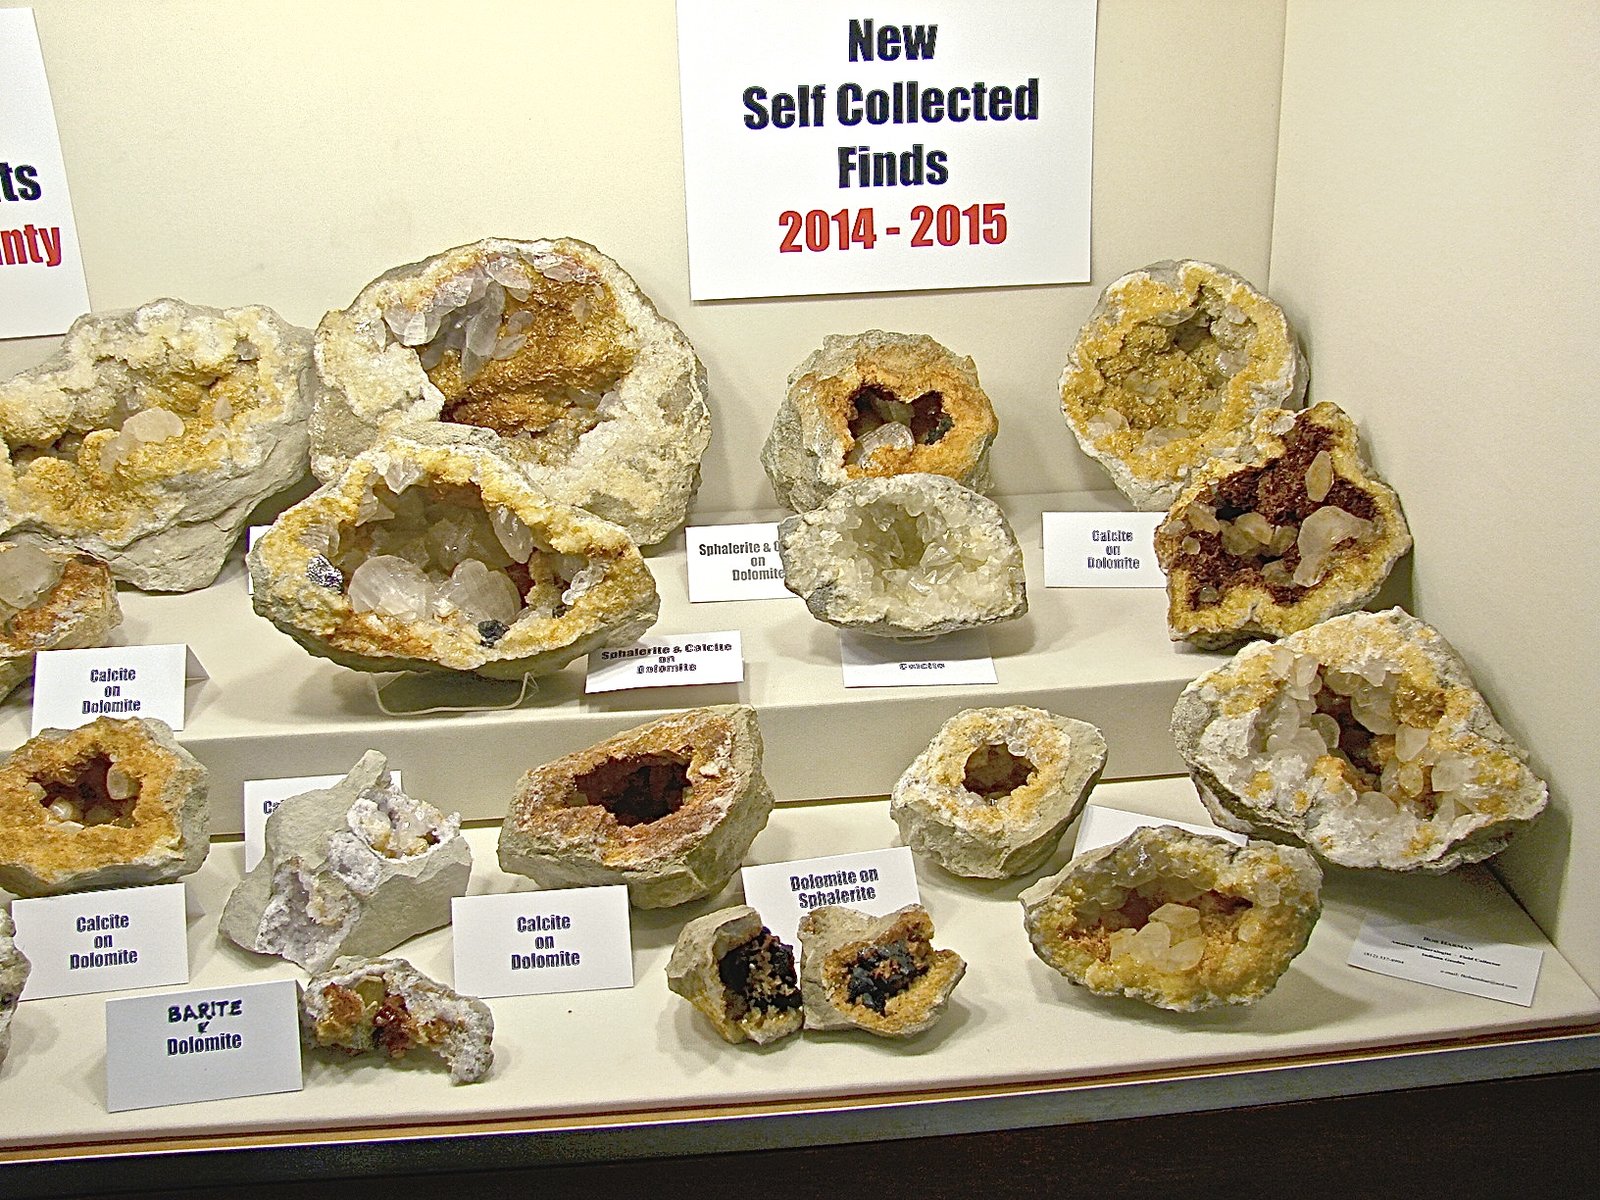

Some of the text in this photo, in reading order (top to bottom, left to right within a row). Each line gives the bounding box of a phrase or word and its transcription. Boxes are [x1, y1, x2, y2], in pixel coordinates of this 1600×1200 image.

[848, 18, 938, 62] New
[743, 77, 1039, 130] Self Collected
[837, 144, 949, 188] Finds
[0, 162, 42, 202] ts
[778, 203, 1007, 253] 2014 - 2015
[0, 224, 62, 267] nty
[1092, 530, 1134, 542] Calcite
[699, 542, 760, 556] Sphalerite
[763, 543, 771, 553] &
[1106, 545, 1121, 556] on
[751, 557, 765, 567] on
[1087, 556, 1140, 569] Dolomite
[732, 568, 785, 581] Dolomite
[602, 643, 732, 660] Sphalerite & Calcite
[659, 656, 675, 664] on
[90, 668, 136, 683] Calcite
[636, 664, 697, 675] Dolomite
[104, 686, 121, 697] on
[82, 699, 141, 714] Dolomite
[790, 868, 880, 892] Dolomite on
[799, 886, 877, 910] Sphalerite
[76, 914, 130, 932] Calcite
[517, 914, 571, 932] Calcite
[94, 935, 113, 949] on
[535, 936, 554, 949] on
[70, 949, 138, 970] Dolomite
[511, 951, 581, 970] Dolomite
[168, 999, 243, 1023] BARITE
[167, 1033, 242, 1056] Dolomite
